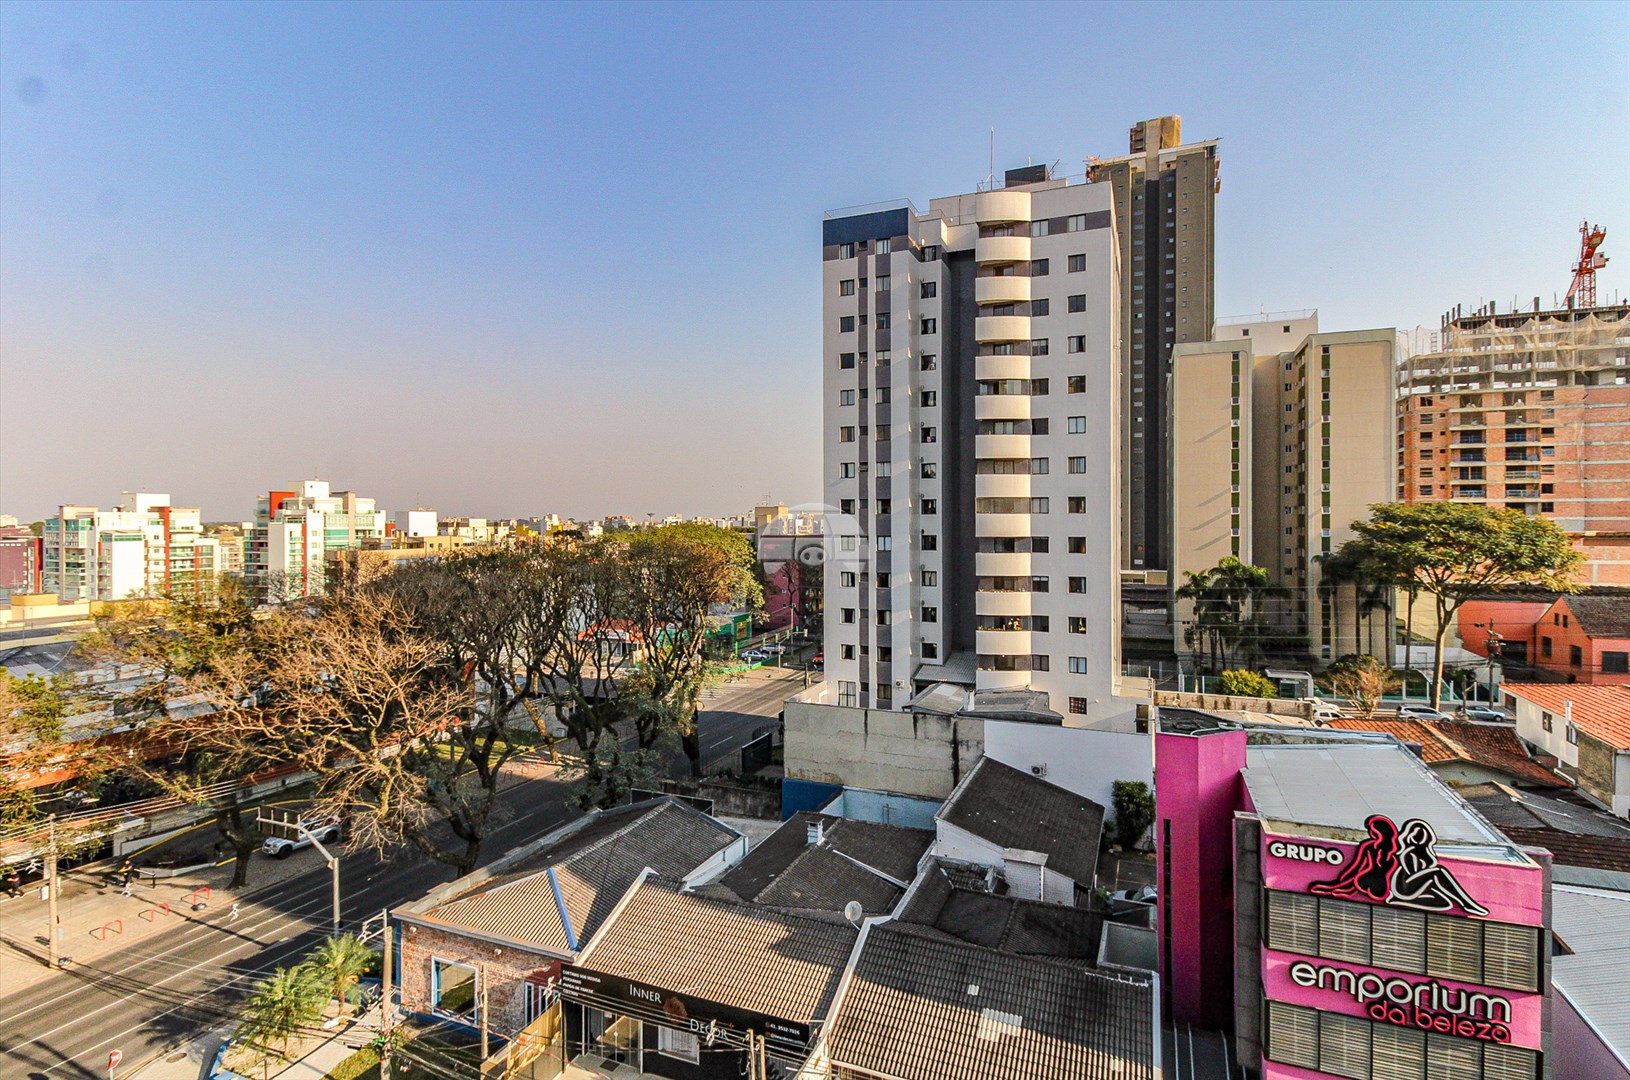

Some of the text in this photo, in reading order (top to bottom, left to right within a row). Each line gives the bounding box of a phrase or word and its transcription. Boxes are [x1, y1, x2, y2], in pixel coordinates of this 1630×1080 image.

[1270, 842, 1343, 865] GRUPO
[629, 983, 662, 1004] INNER
[1291, 962, 1511, 1023] emporium
[1369, 1001, 1511, 1043] da beleza
